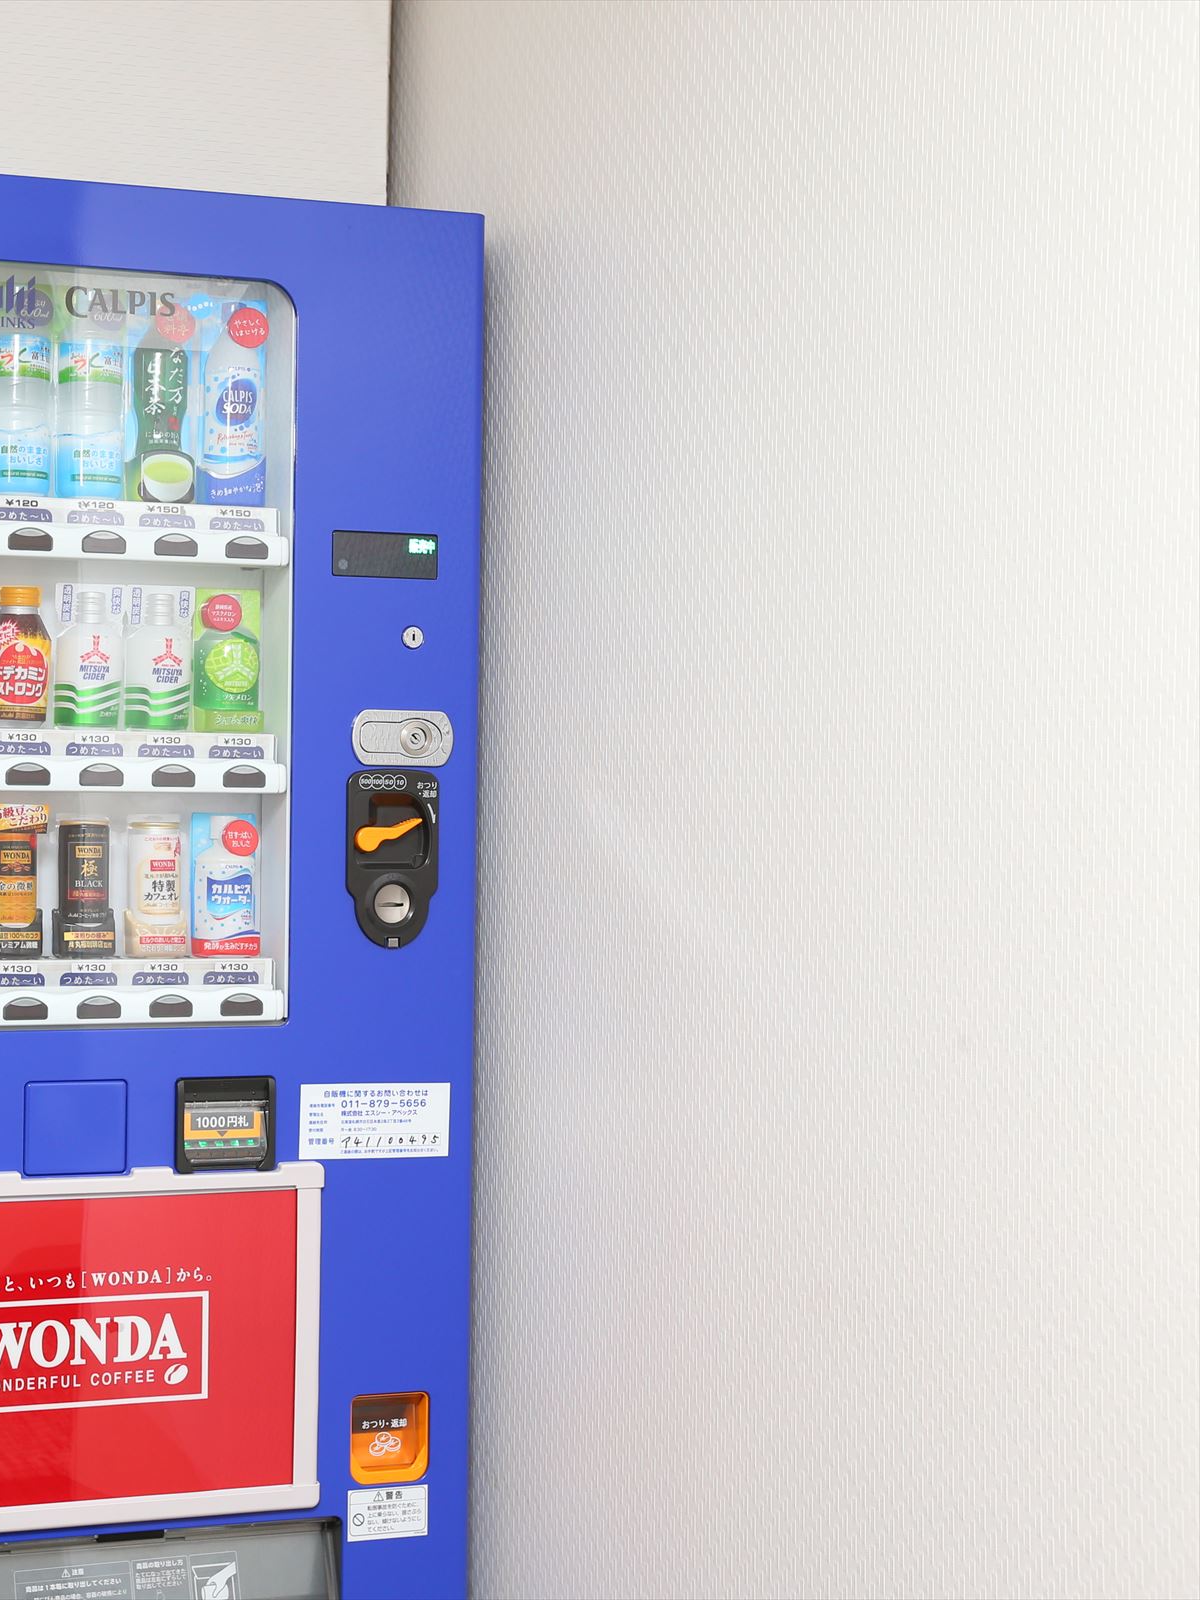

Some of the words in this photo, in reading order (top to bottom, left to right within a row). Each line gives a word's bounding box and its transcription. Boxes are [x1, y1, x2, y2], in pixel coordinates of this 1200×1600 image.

[65, 286, 175, 318] CALPIS
[168, 347, 184, 404] なだ万
[223, 390, 252, 403] CALPIS
[222, 403, 251, 414] SODA
[5, 499, 39, 507] ¥120
[81, 501, 115, 510] ¥120
[147, 505, 179, 514] ¥150
[219, 509, 251, 517] ¥150
[80, 665, 110, 673] MITSUYA
[152, 668, 182, 676] MITSUYA
[8, 733, 37, 741] ¥130
[9, 813, 47, 826] こだわり
[81, 860, 98, 877] 極
[75, 880, 103, 888] BLACK
[152, 881, 176, 892] 特製
[211, 884, 252, 895] カルピス
[144, 892, 179, 901] カフェオレ
[211, 895, 250, 905] ウォーター
[3, 965, 32, 973] ¥130
[220, 963, 248, 971] ¥130
[324, 1090, 428, 1098] 自販機に関するお問い合わせは
[341, 1099, 427, 1108] 011-879-5656
[196, 1115, 248, 1128] 1000円札
[91, 1369, 155, 1387] COFFEE
[362, 1418, 407, 1429] おつり・返却
[386, 1491, 402, 1500] 警告
[136, 1559, 183, 1570] 商品の取り出し方
